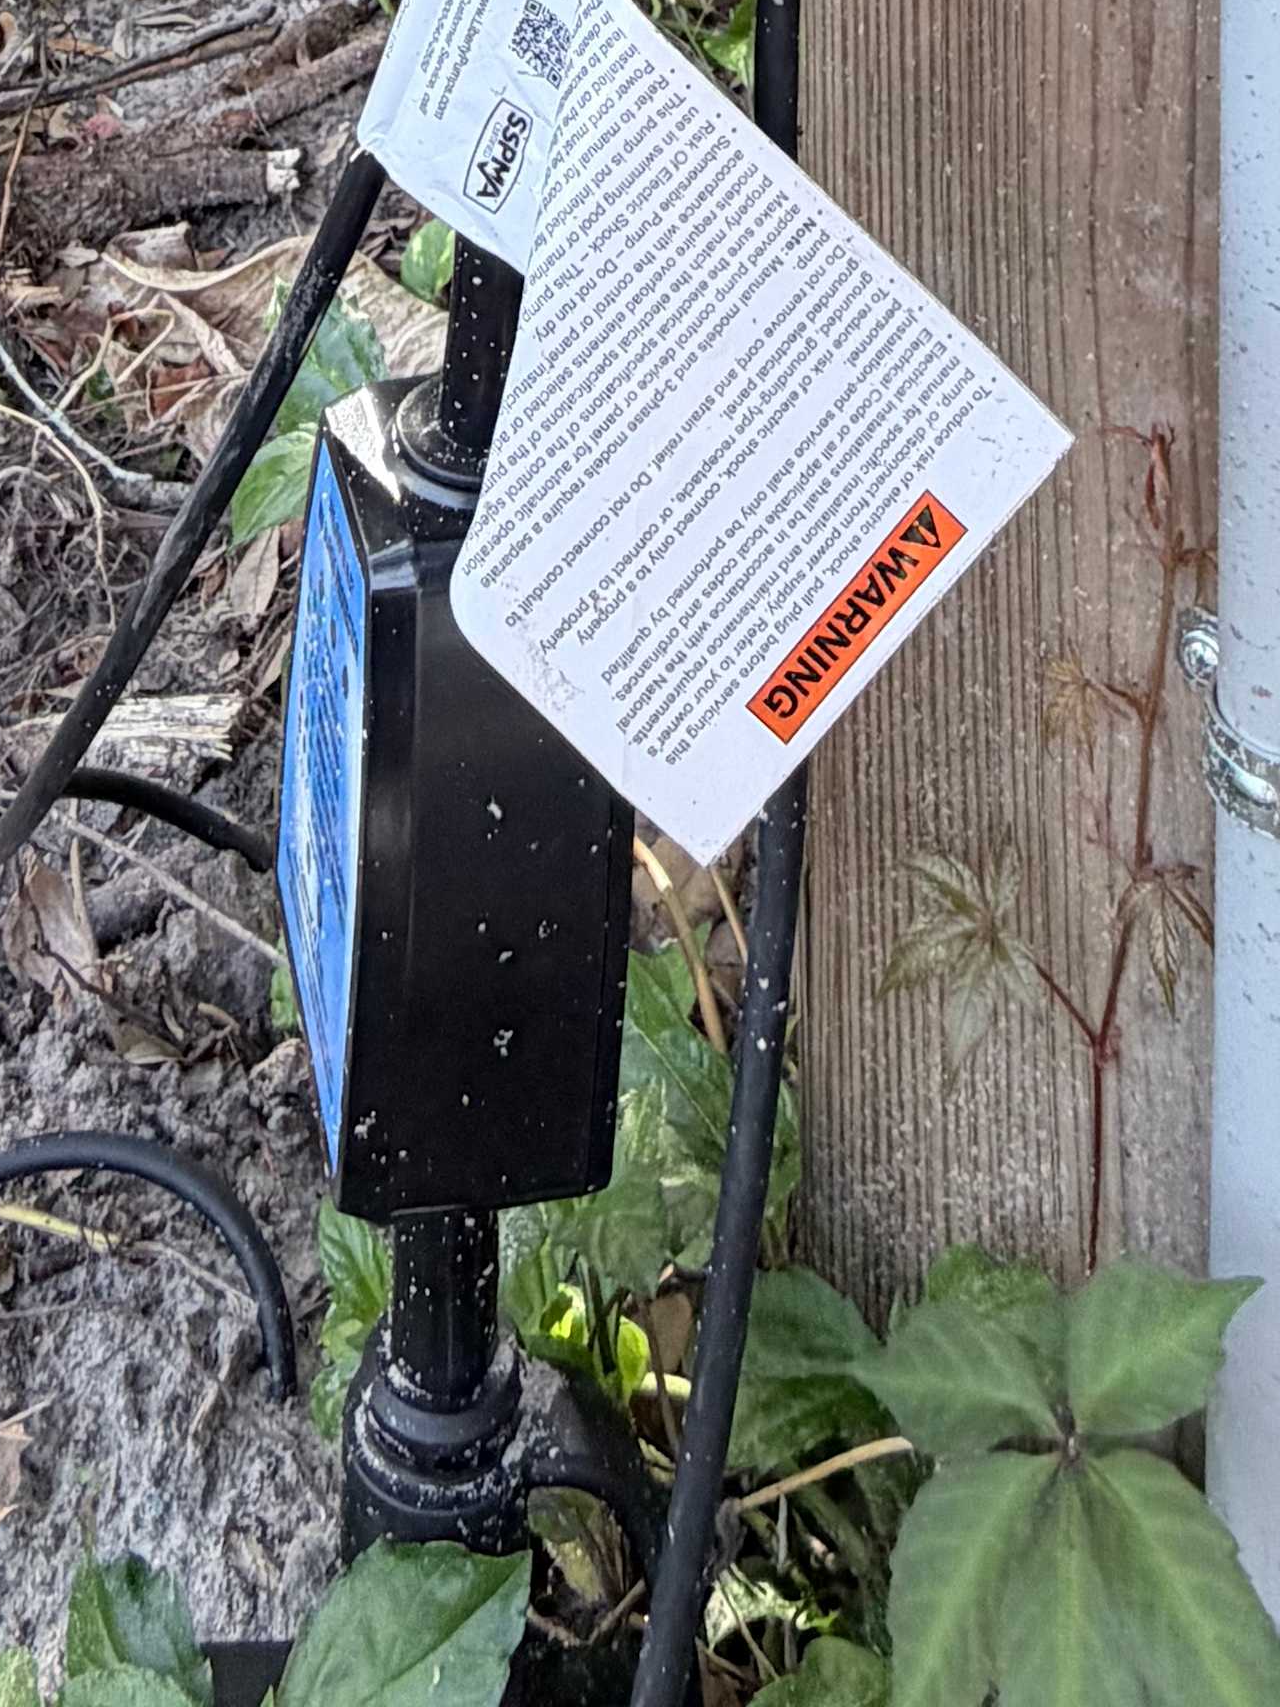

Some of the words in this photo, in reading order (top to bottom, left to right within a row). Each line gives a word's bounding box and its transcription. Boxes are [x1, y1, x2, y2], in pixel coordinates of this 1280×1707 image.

[424, 45, 450, 89] Service,
[418, 91, 430, 116] call
[476, 111, 528, 197] SSPMA
[892, 339, 948, 403] Electrical
[917, 355, 960, 407] manual
[935, 366, 975, 407] pump,
[971, 384, 992, 401] To
[901, 403, 922, 425] for
[924, 410, 940, 430] or
[933, 400, 974, 446] reduce
[859, 422, 904, 475] specific
[864, 425, 926, 499] disconnect
[911, 444, 936, 472] risk
[801, 476, 832, 513] shall
[899, 470, 914, 491] of
[786, 509, 807, 530] be
[800, 473, 864, 545] installation
[839, 495, 870, 529] from
[859, 485, 901, 535] electric
[773, 528, 791, 544] in
[805, 525, 842, 572] power
[821, 534, 862, 576] shock,
[776, 543, 803, 575] and
[708, 542, 775, 620] accordance
[763, 568, 807, 616] supply.
[800, 574, 824, 607] pull
[705, 570, 780, 656] maintenance
[761, 545, 920, 719] WARNING
[773, 600, 803, 635] plug
[683, 620, 712, 650] with
[732, 615, 769, 657] Refer
[738, 633, 780, 678] before
[663, 649, 688, 673] the
[719, 654, 736, 671] to
[615, 672, 668, 735] National
[627, 654, 708, 746] requirements.
[693, 667, 722, 705] your
[646, 701, 694, 758] owner's
[684, 677, 740, 740] servicing
[664, 738, 691, 765] this
